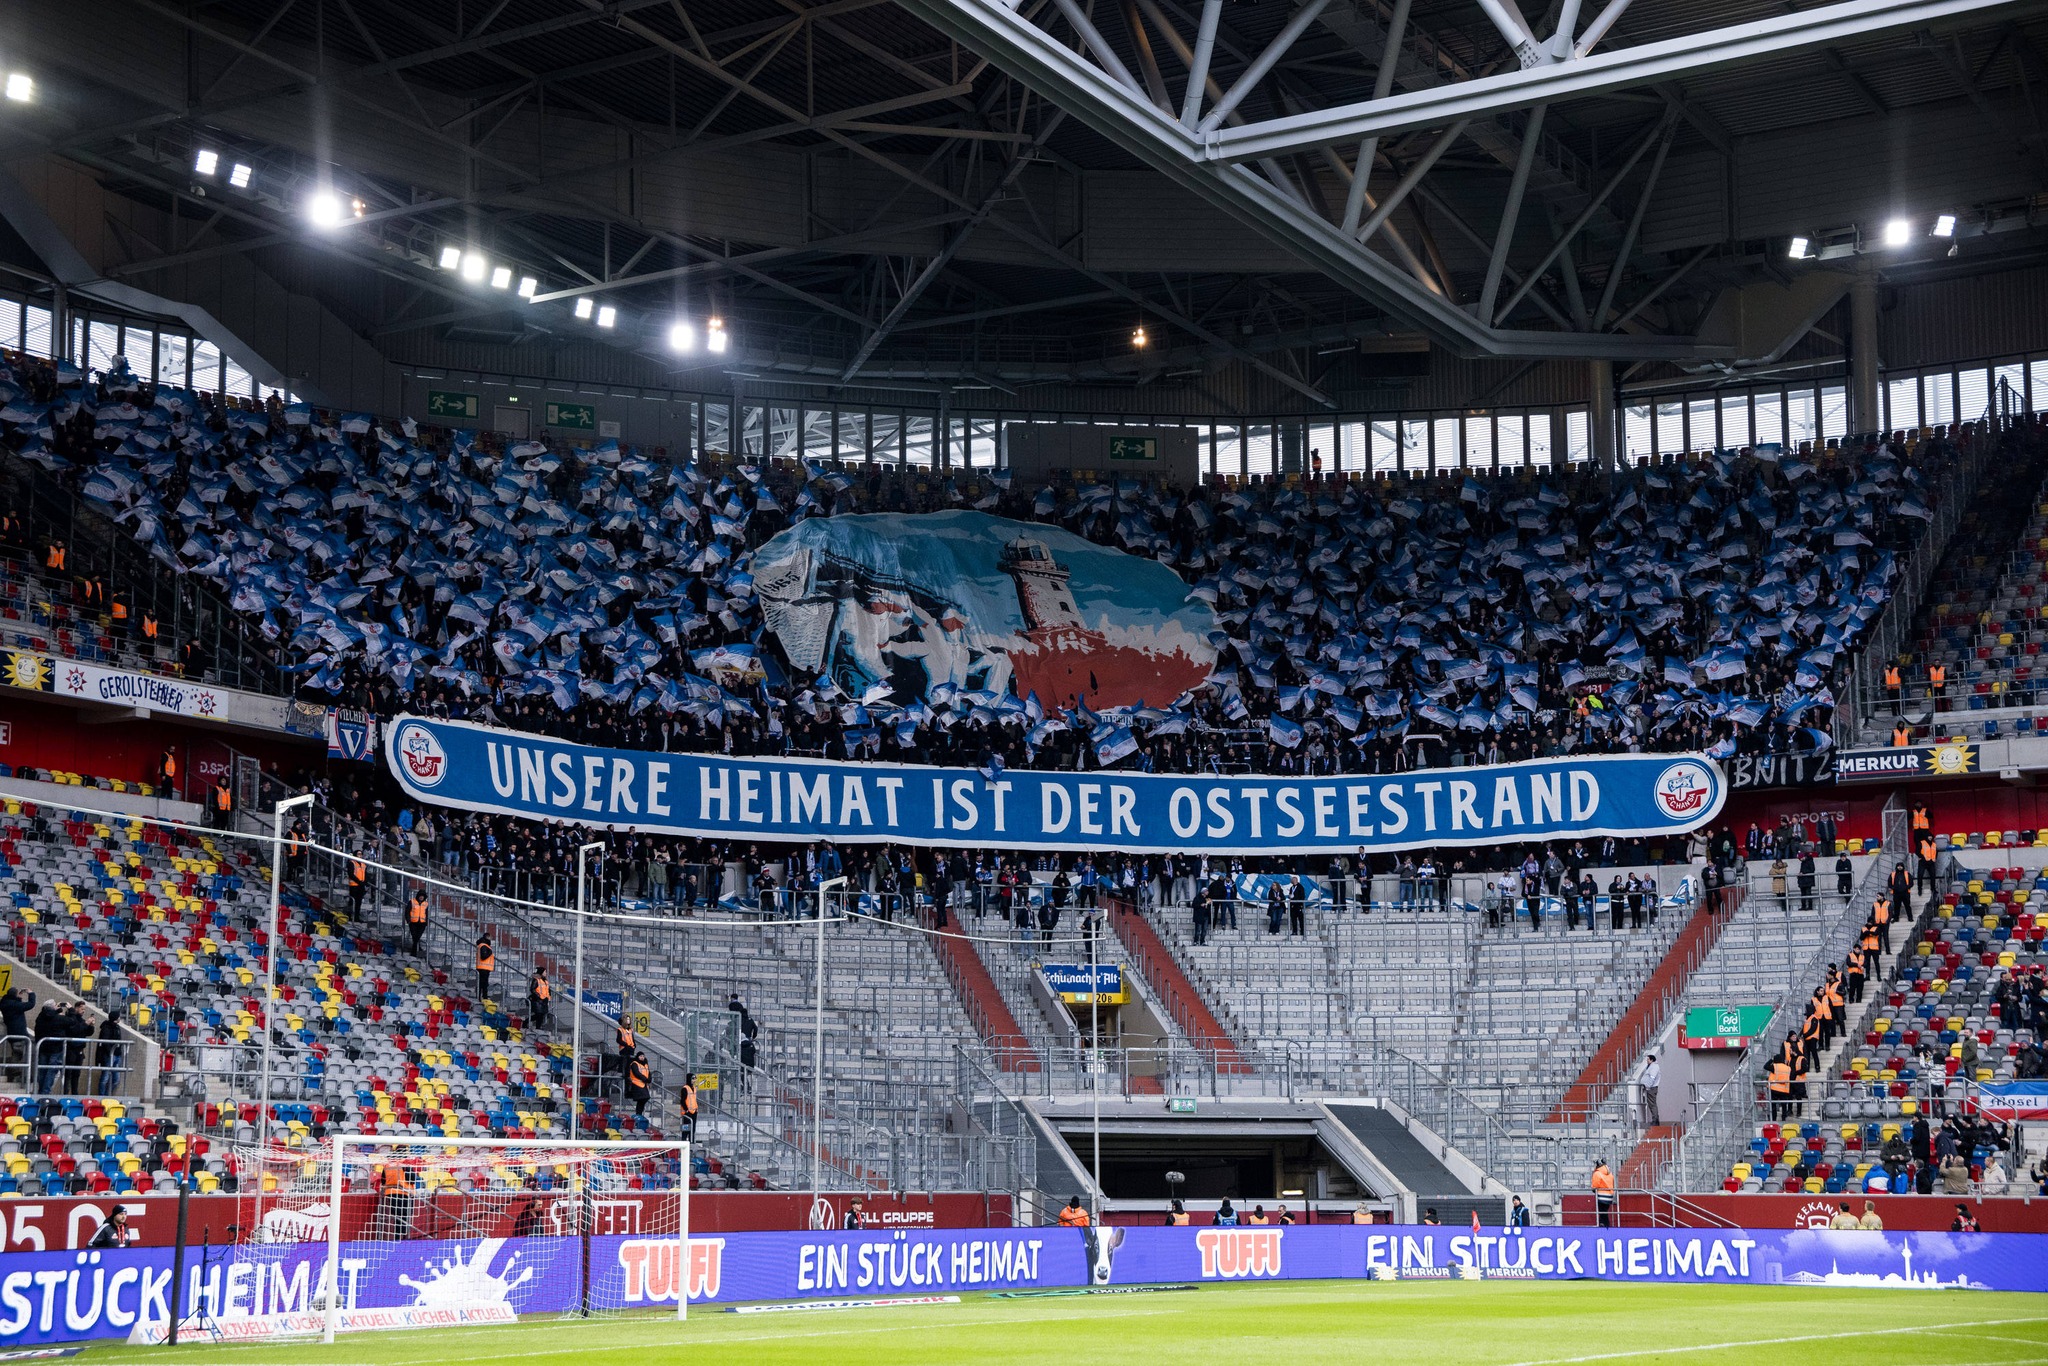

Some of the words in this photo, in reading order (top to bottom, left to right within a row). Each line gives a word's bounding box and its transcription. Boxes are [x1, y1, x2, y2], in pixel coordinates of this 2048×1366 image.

[1839, 754, 1919, 773] MERKUR
[487, 742, 671, 817] UNSERE
[699, 766, 904, 827] HEIMAT
[932, 778, 1013, 833] IST
[1041, 782, 1141, 837] DER
[1168, 770, 1600, 839] OSTSEESTRAND
[1701, 1038, 1714, 1049] 21
[883, 1211, 935, 1223] GRUPPE
[797, 1243, 849, 1292] EIN
[857, 1230, 944, 1288] STÜCK
[950, 1240, 1043, 1284] HEIMAT
[1198, 1230, 1281, 1276] TUFFI
[1366, 1235, 1434, 1269] EIN
[1450, 1226, 1583, 1275] STÜCK
[1596, 1238, 1756, 1278] HEIMAT
[1401, 1267, 1451, 1277] MERKUR
[1486, 1267, 1535, 1277] MERKUR
[0, 1250, 173, 1336] STÜCK
[188, 1258, 367, 1319] HEIMAT
[281, 1315, 338, 1332] KÜCHE
[341, 1312, 399, 1328] AKTUELL
[404, 1309, 456, 1326] KÜCHEN
[459, 1306, 512, 1323] AKTUELL
